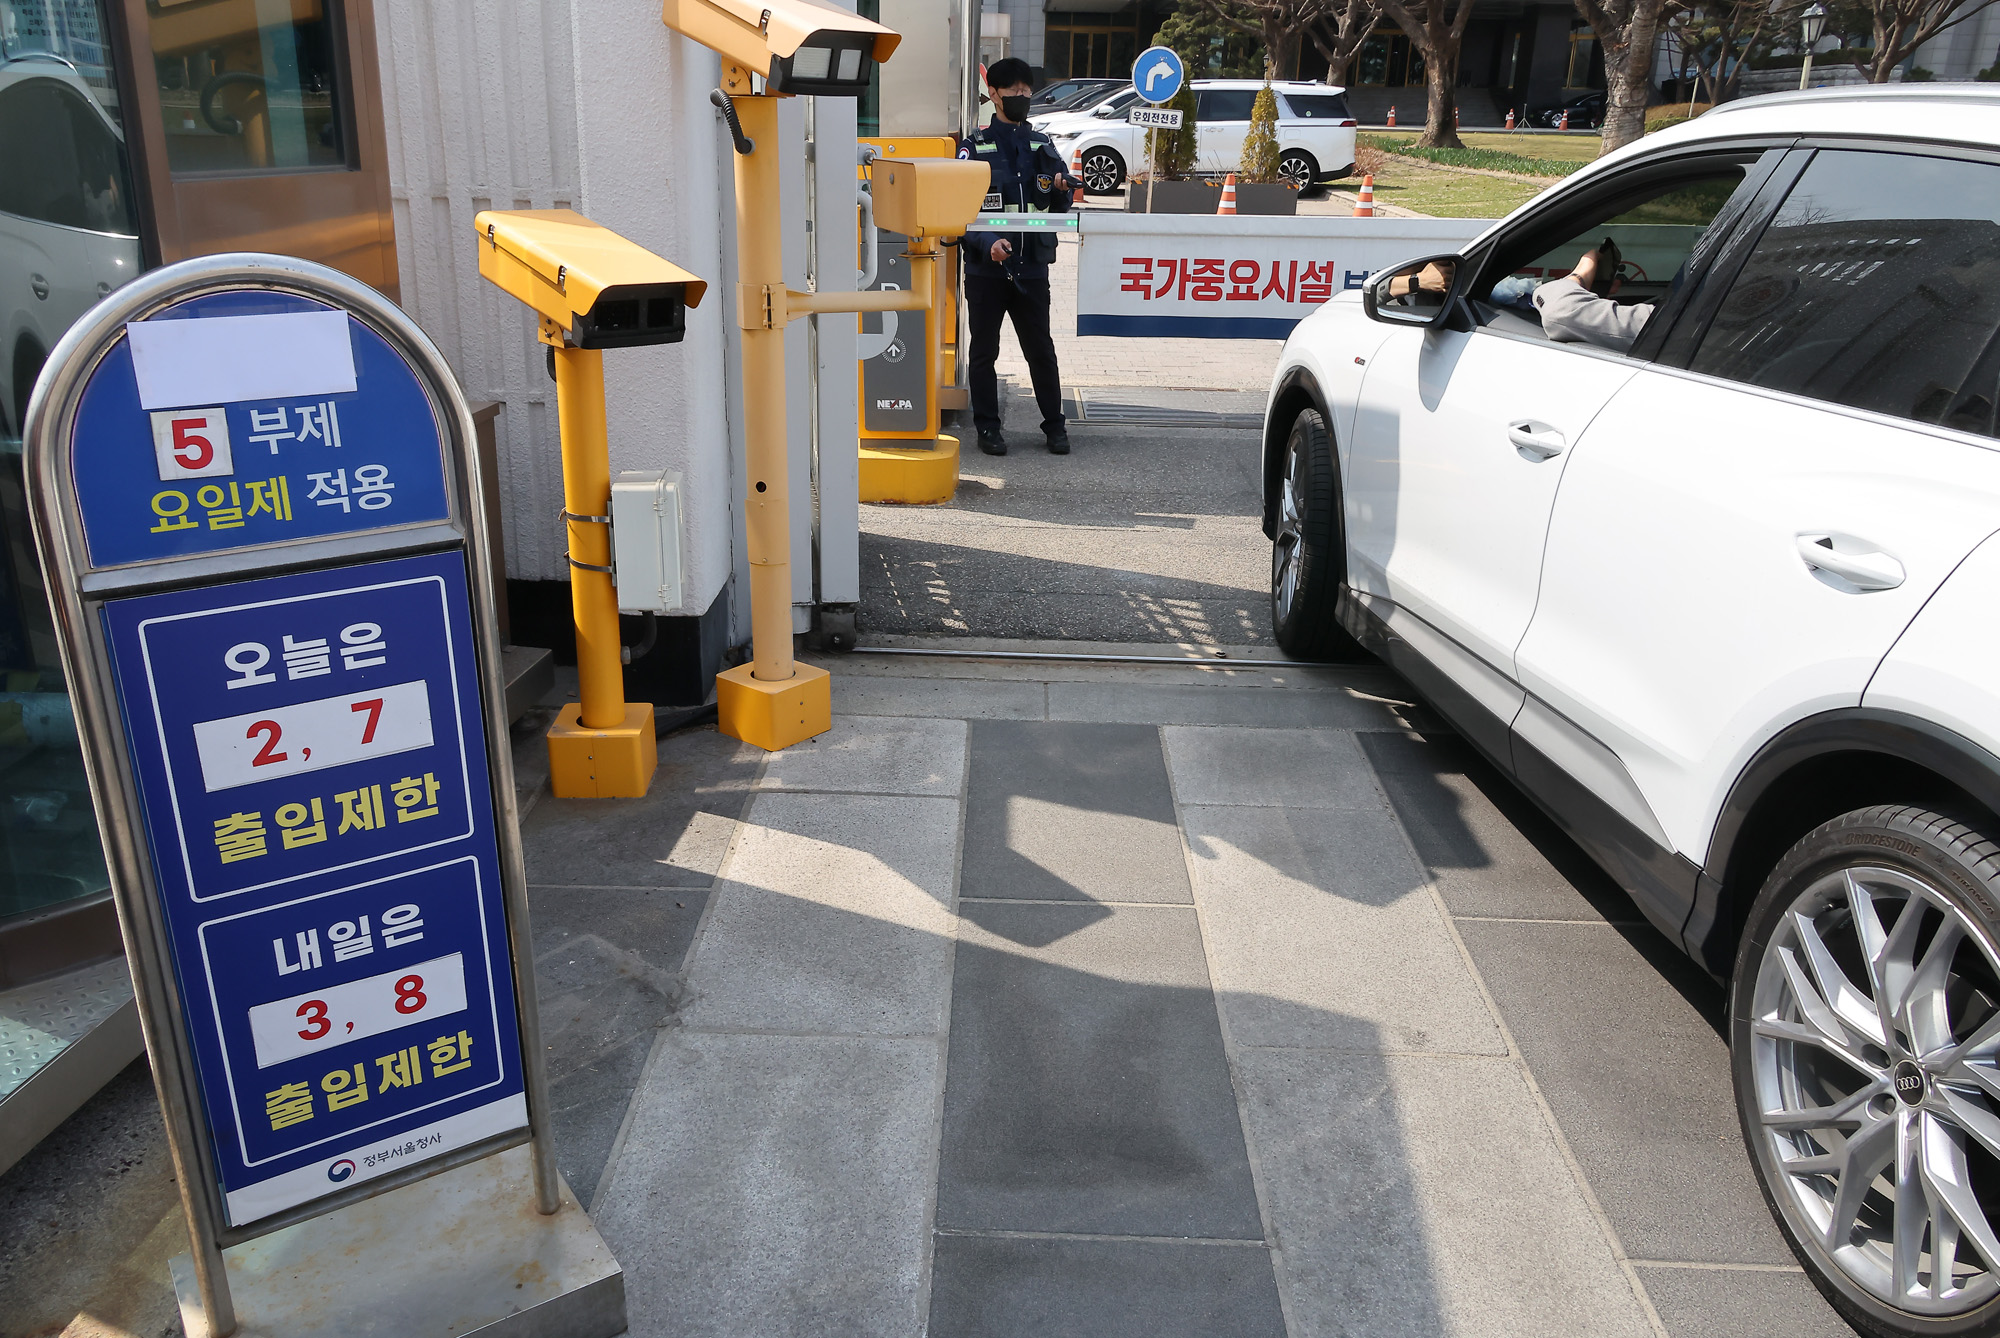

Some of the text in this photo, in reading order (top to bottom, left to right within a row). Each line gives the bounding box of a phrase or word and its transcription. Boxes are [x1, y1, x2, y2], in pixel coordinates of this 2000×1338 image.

[1133, 110, 1179, 126] 우회전전용
[1120, 257, 1335, 304] 국가중요시설
[172, 401, 342, 469] 5 부제
[876, 399, 912, 408] NEXPA
[149, 464, 395, 534] 요일제 적용
[224, 622, 387, 690] 오늘은
[246, 698, 384, 767] 2, 7
[213, 772, 441, 865] 출입제한
[1846, 832, 1921, 857] BRIDGESTONE
[273, 903, 425, 976] 내일은
[296, 974, 427, 1040] 3, 8
[265, 1030, 473, 1131] 출입제한
[363, 1132, 442, 1168] 정부서울청사
